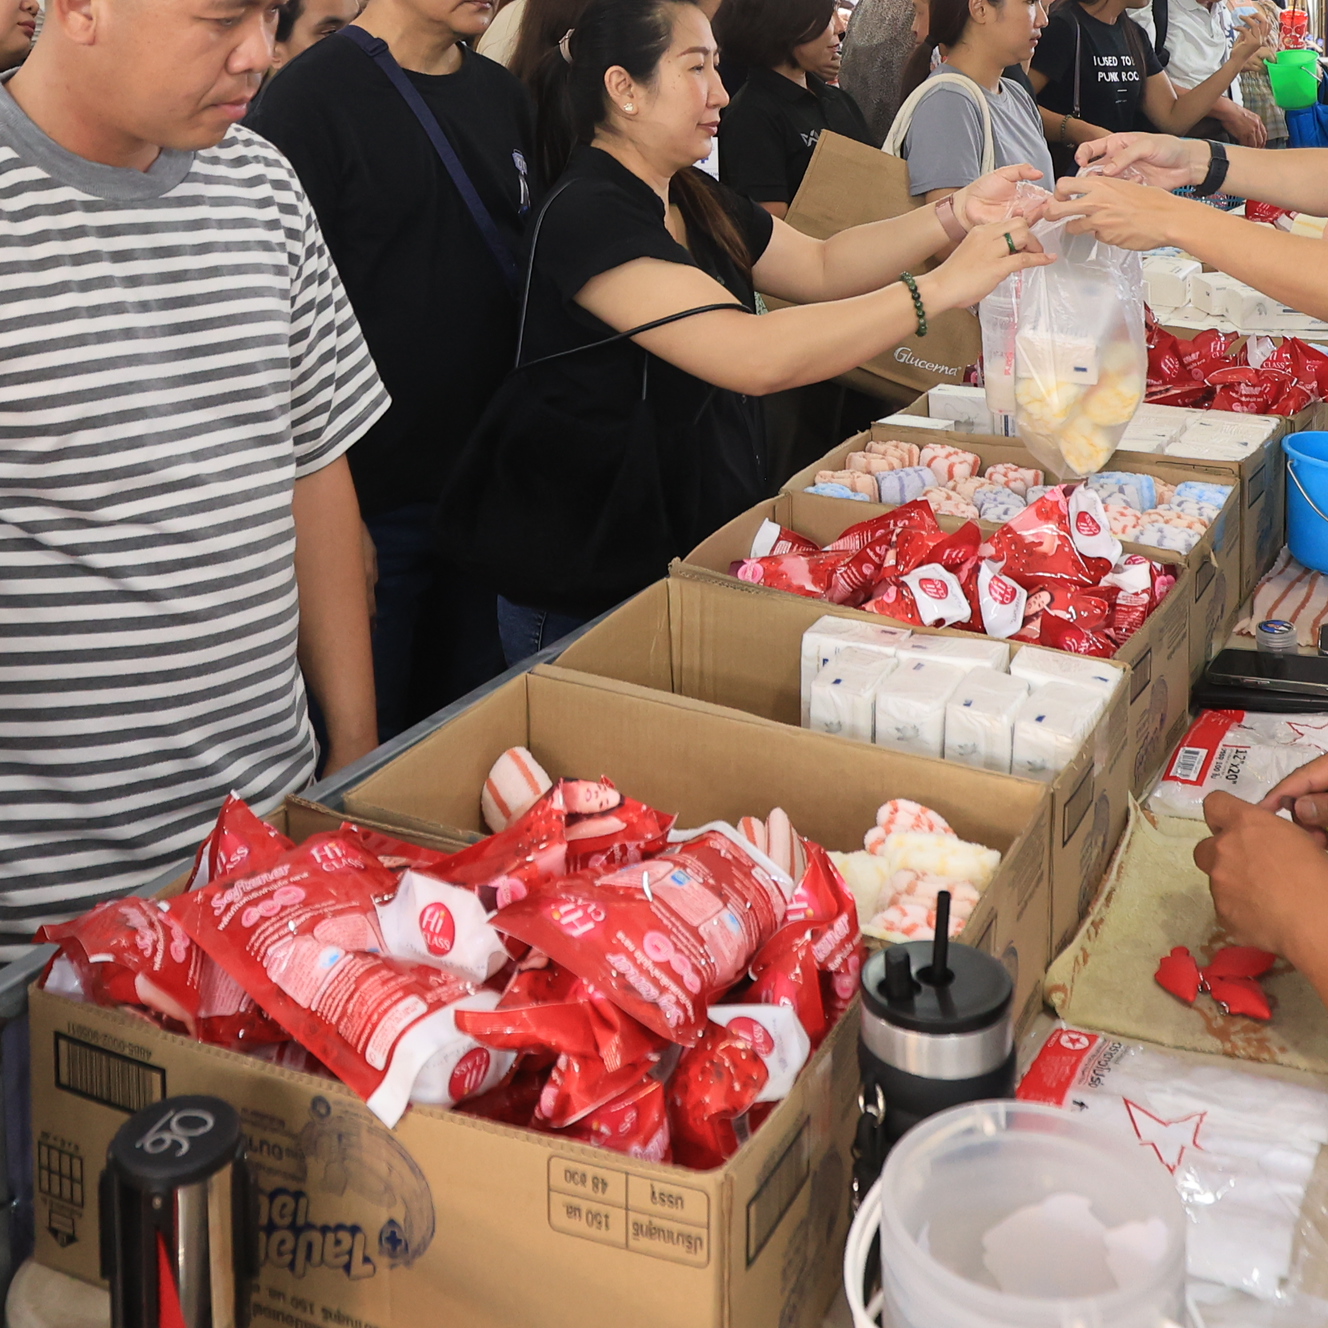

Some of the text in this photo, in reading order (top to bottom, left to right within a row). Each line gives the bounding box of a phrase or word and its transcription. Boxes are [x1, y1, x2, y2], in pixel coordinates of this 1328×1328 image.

[1093, 55, 1131, 67] I USED TO
[1097, 71, 1120, 82] PUNK
[894, 346, 958, 377] Glucerna
[1262, 360, 1287, 370] CLASS
[1214, 761, 1223, 771] 100
[310, 840, 346, 864] Hi
[421, 909, 447, 935] Hi
[550, 901, 596, 938] Hi
[591, 1176, 609, 1196] 48
[649, 1183, 685, 1211] บรรจุ
[585, 1212, 610, 1232] 150
[631, 1219, 704, 1256] ปริมาณสุทธิ
[259, 1223, 377, 1281] ไลปอ
